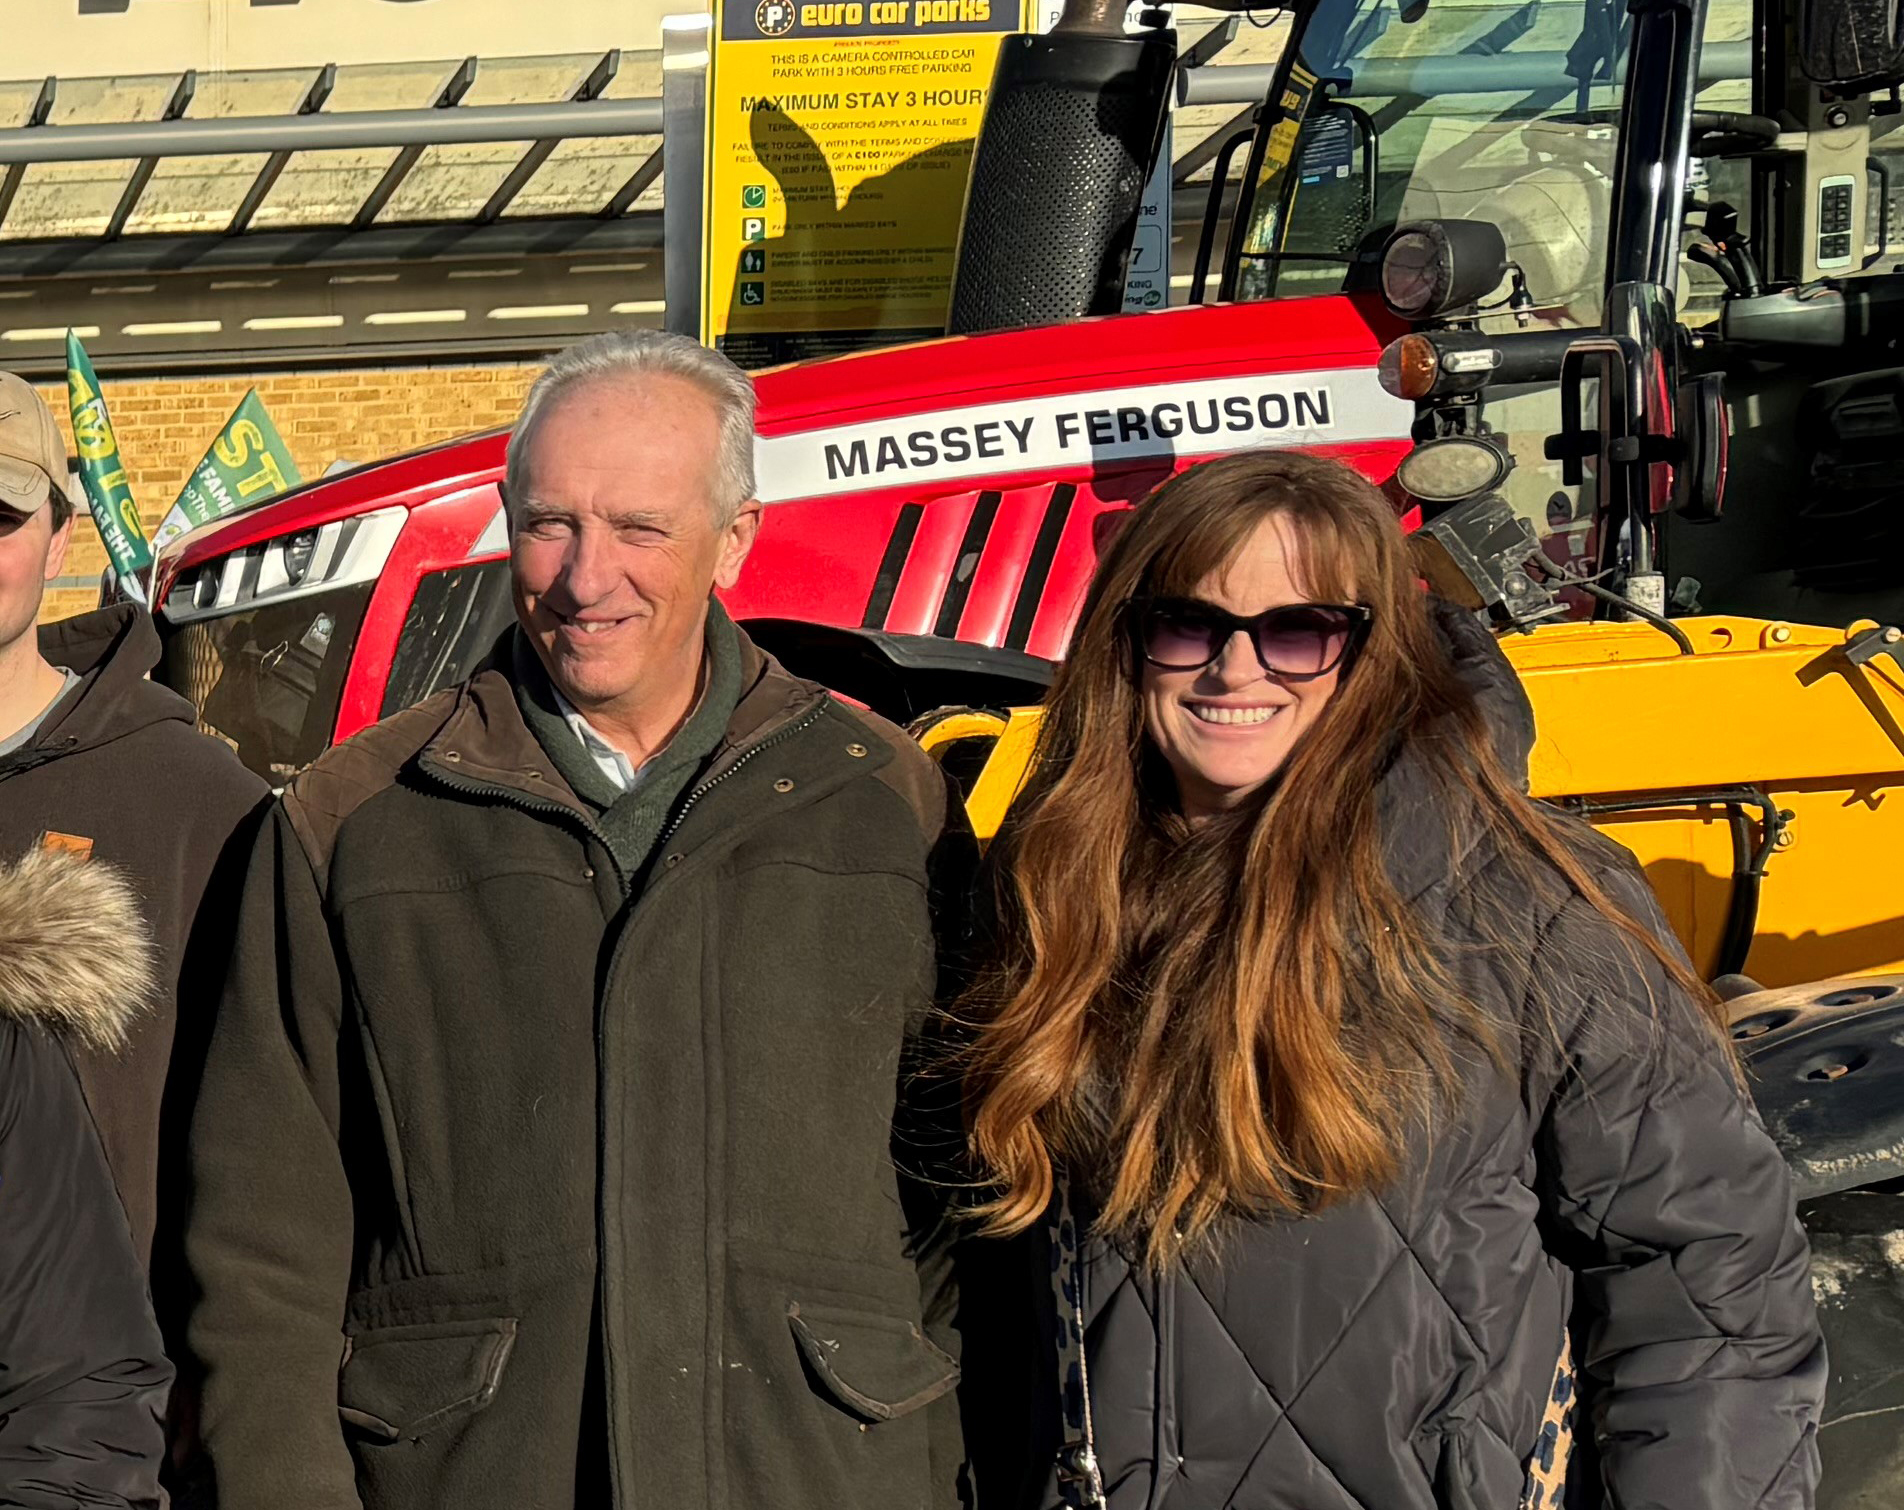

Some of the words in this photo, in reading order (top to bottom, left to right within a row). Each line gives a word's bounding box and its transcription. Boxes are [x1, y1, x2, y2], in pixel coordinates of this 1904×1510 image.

[800, 3, 863, 27] euro
[869, 2, 909, 25] car
[914, 0, 990, 26] parks
[771, 55, 795, 65] THIS
[798, 54, 809, 64] IS
[811, 53, 820, 64] A
[822, 52, 870, 63] CAMERA
[872, 50, 948, 62] CONTROLLED
[951, 49, 975, 59] CAR
[773, 67, 803, 78] PARK
[806, 66, 835, 77] WITH
[837, 66, 845, 76] 3
[847, 65, 886, 76] HOURS
[888, 64, 919, 75] FREE
[921, 63, 971, 74] PARKING
[741, 93, 839, 112] MAXIMUM
[845, 92, 899, 109] STAY
[905, 91, 917, 107] 3
[821, 120, 877, 130] CONDITIONS
[878, 119, 907, 129] APPLY
[823, 417, 1035, 481] MASSEY
[1055, 388, 1331, 450] FERGUSON
